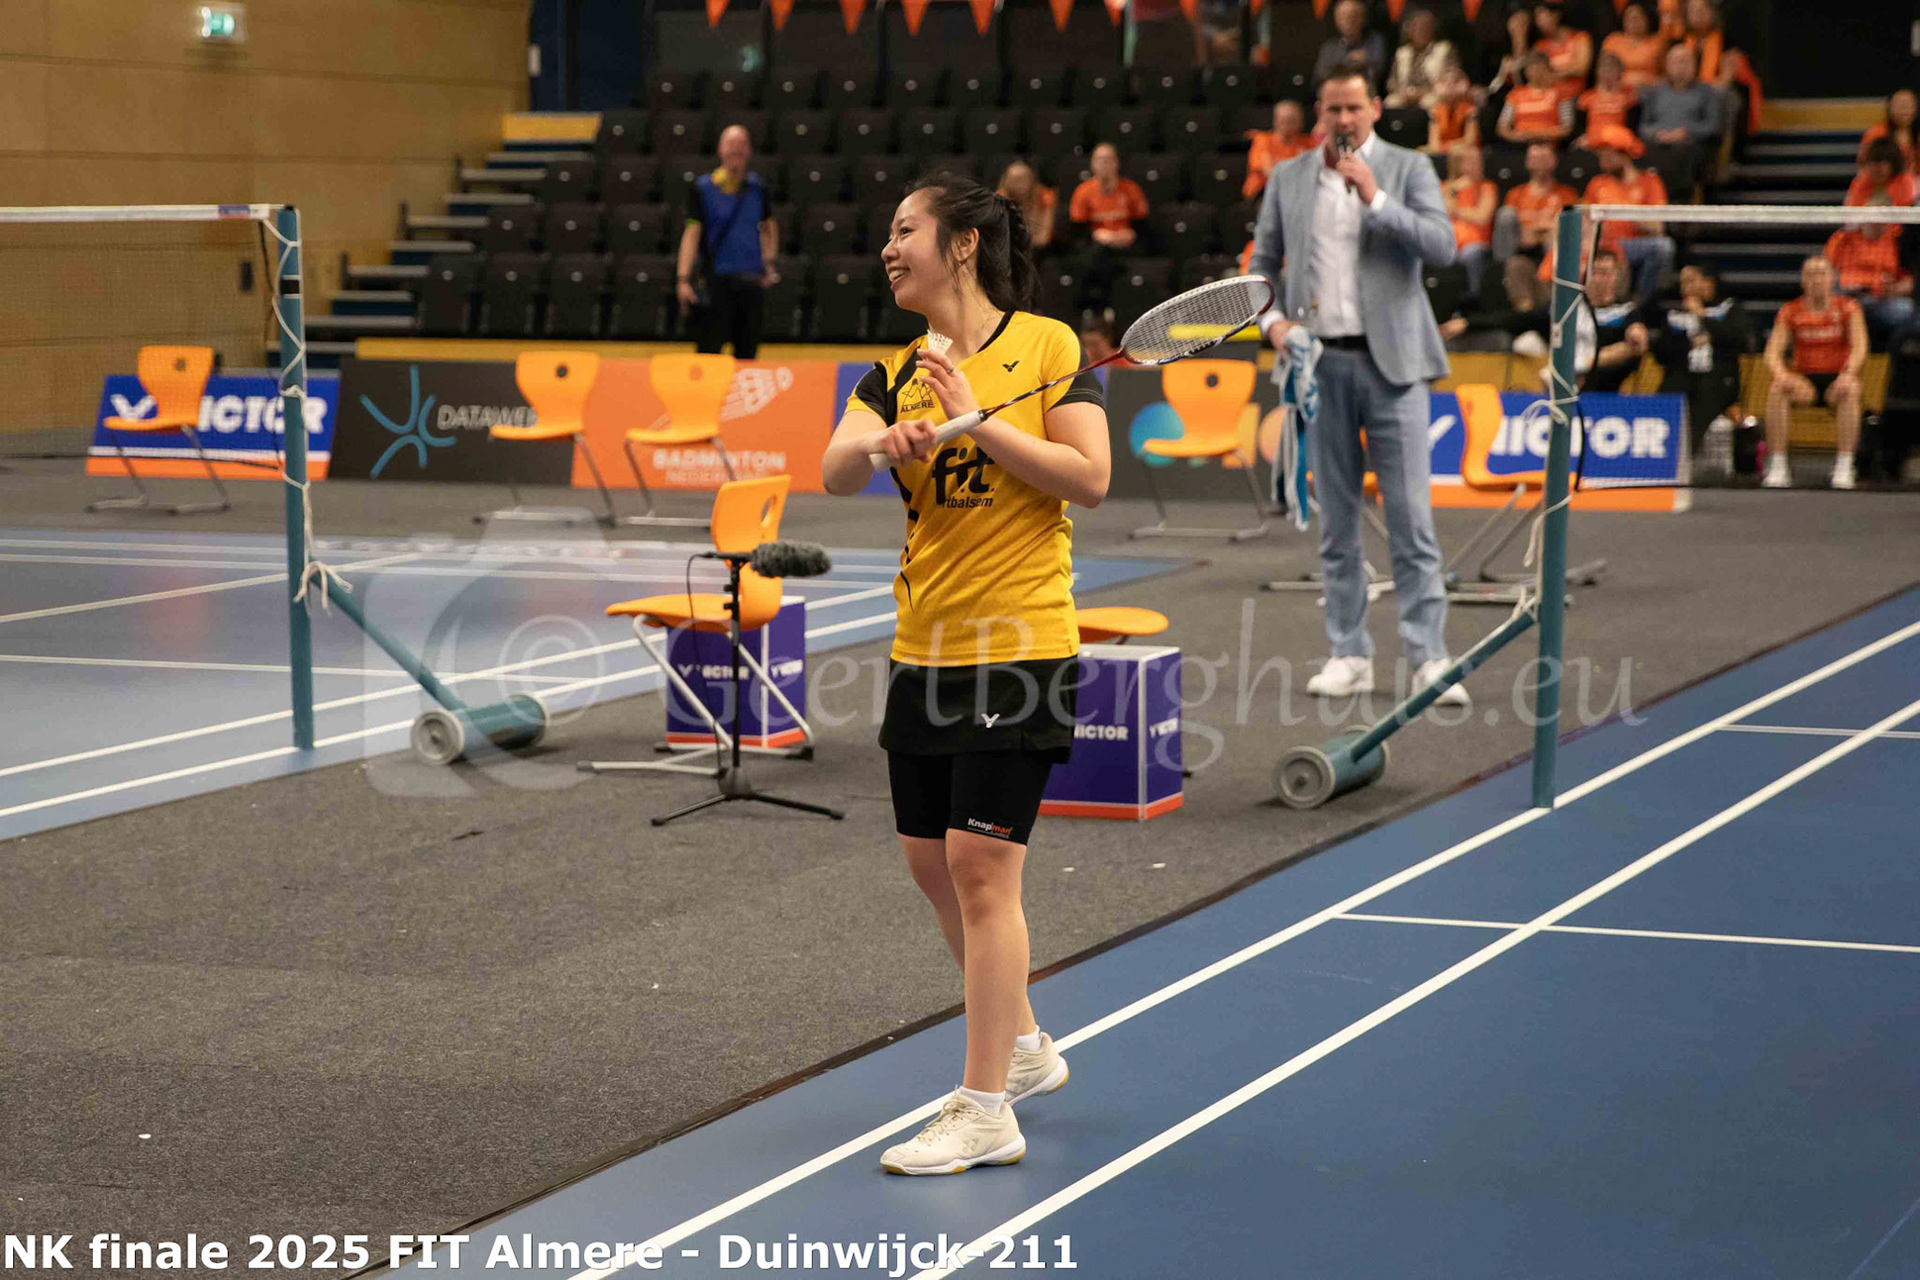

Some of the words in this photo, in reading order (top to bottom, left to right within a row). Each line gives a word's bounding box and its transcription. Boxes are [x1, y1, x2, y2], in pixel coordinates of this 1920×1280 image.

[197, 394, 328, 434] ICTOR
[900, 401, 935, 413] ALMERE
[967, 818, 1012, 835] Knapman
